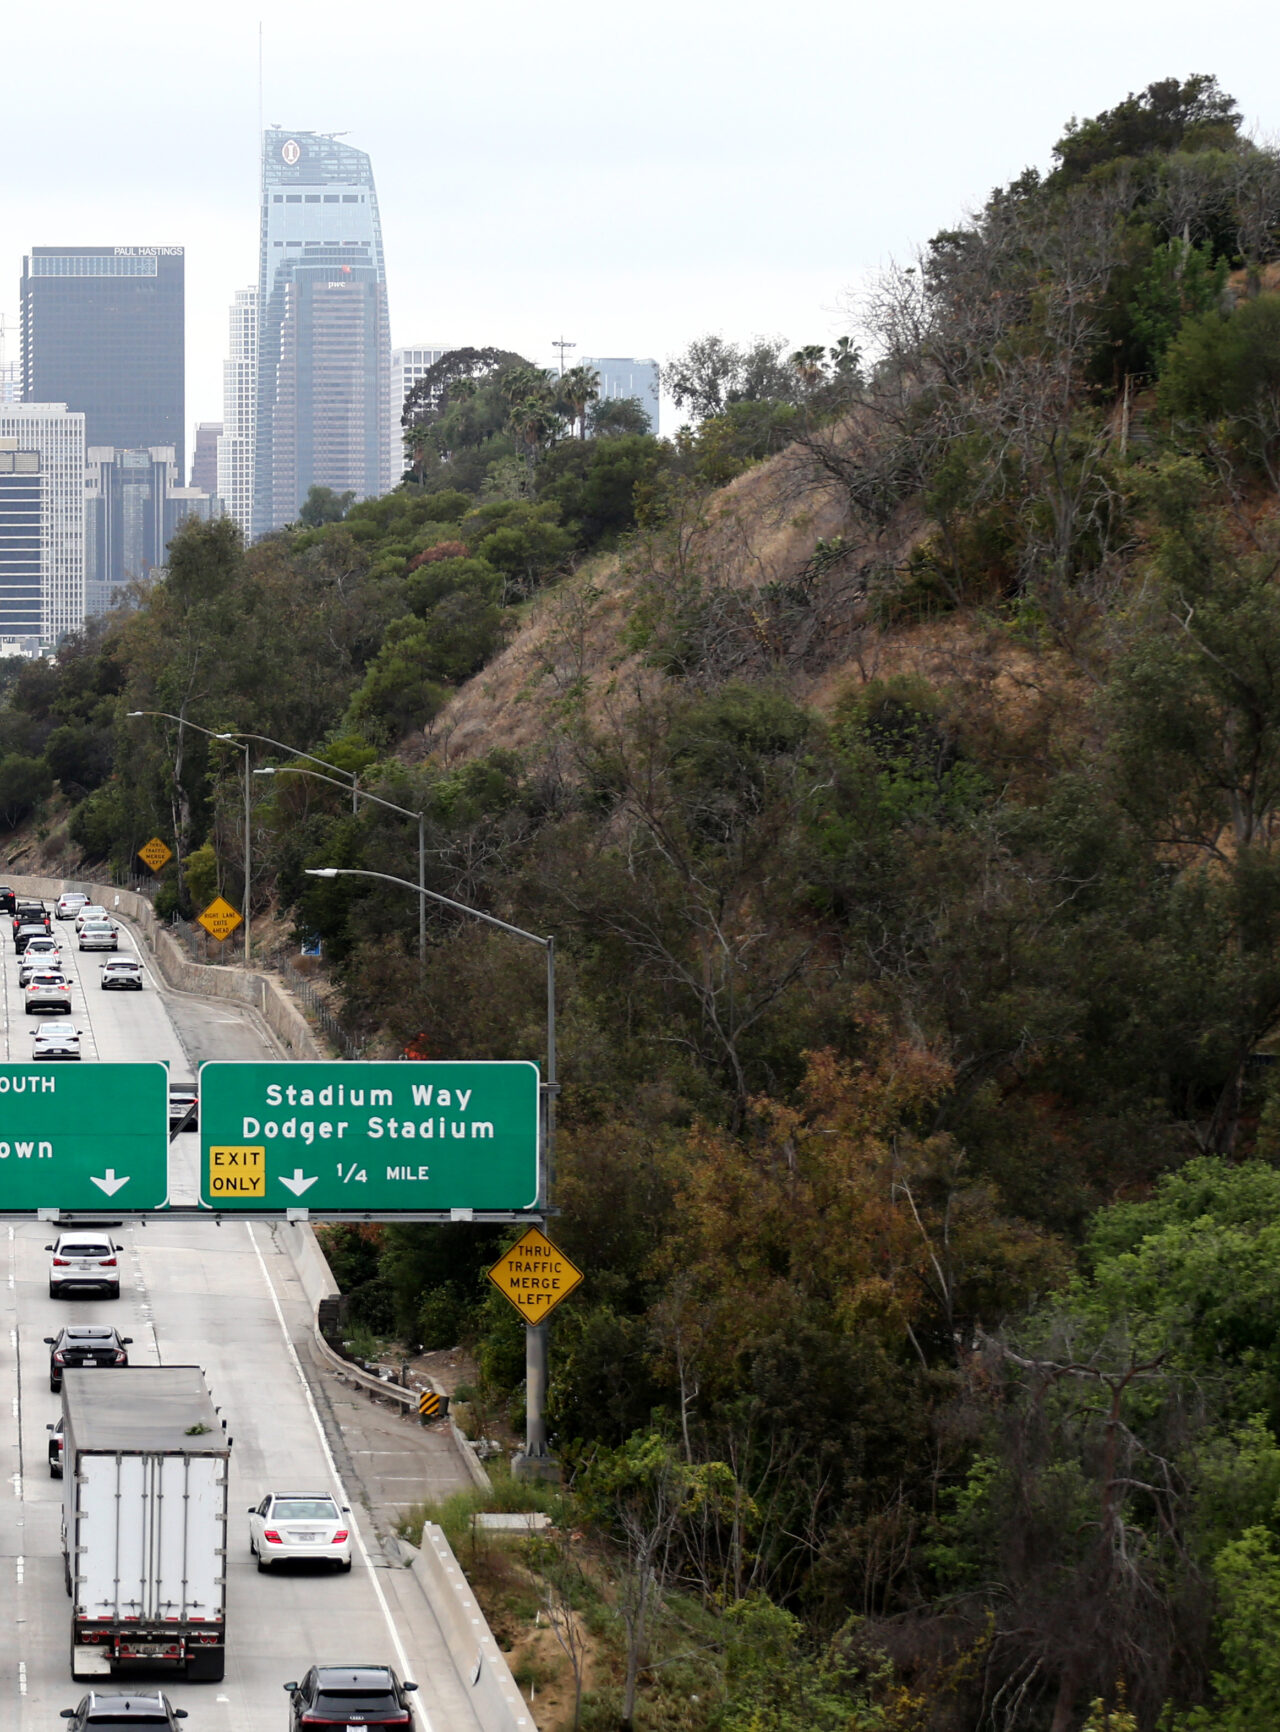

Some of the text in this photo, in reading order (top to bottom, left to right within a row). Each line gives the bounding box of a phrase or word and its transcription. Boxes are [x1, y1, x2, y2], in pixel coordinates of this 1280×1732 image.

[114, 247, 184, 256] PAUL HASTINGS
[265, 1084, 472, 1112] Stadium Way
[242, 1116, 495, 1145] Dodger Stadium
[214, 1152, 261, 1166] EXIT
[386, 1166, 430, 1181] MILE
[212, 1177, 261, 1191] ONLY
[518, 1245, 551, 1257] THRU
[508, 1260, 562, 1273] TRAFFIC
[510, 1277, 561, 1289] MERGE
[517, 1293, 553, 1305] LEFT
